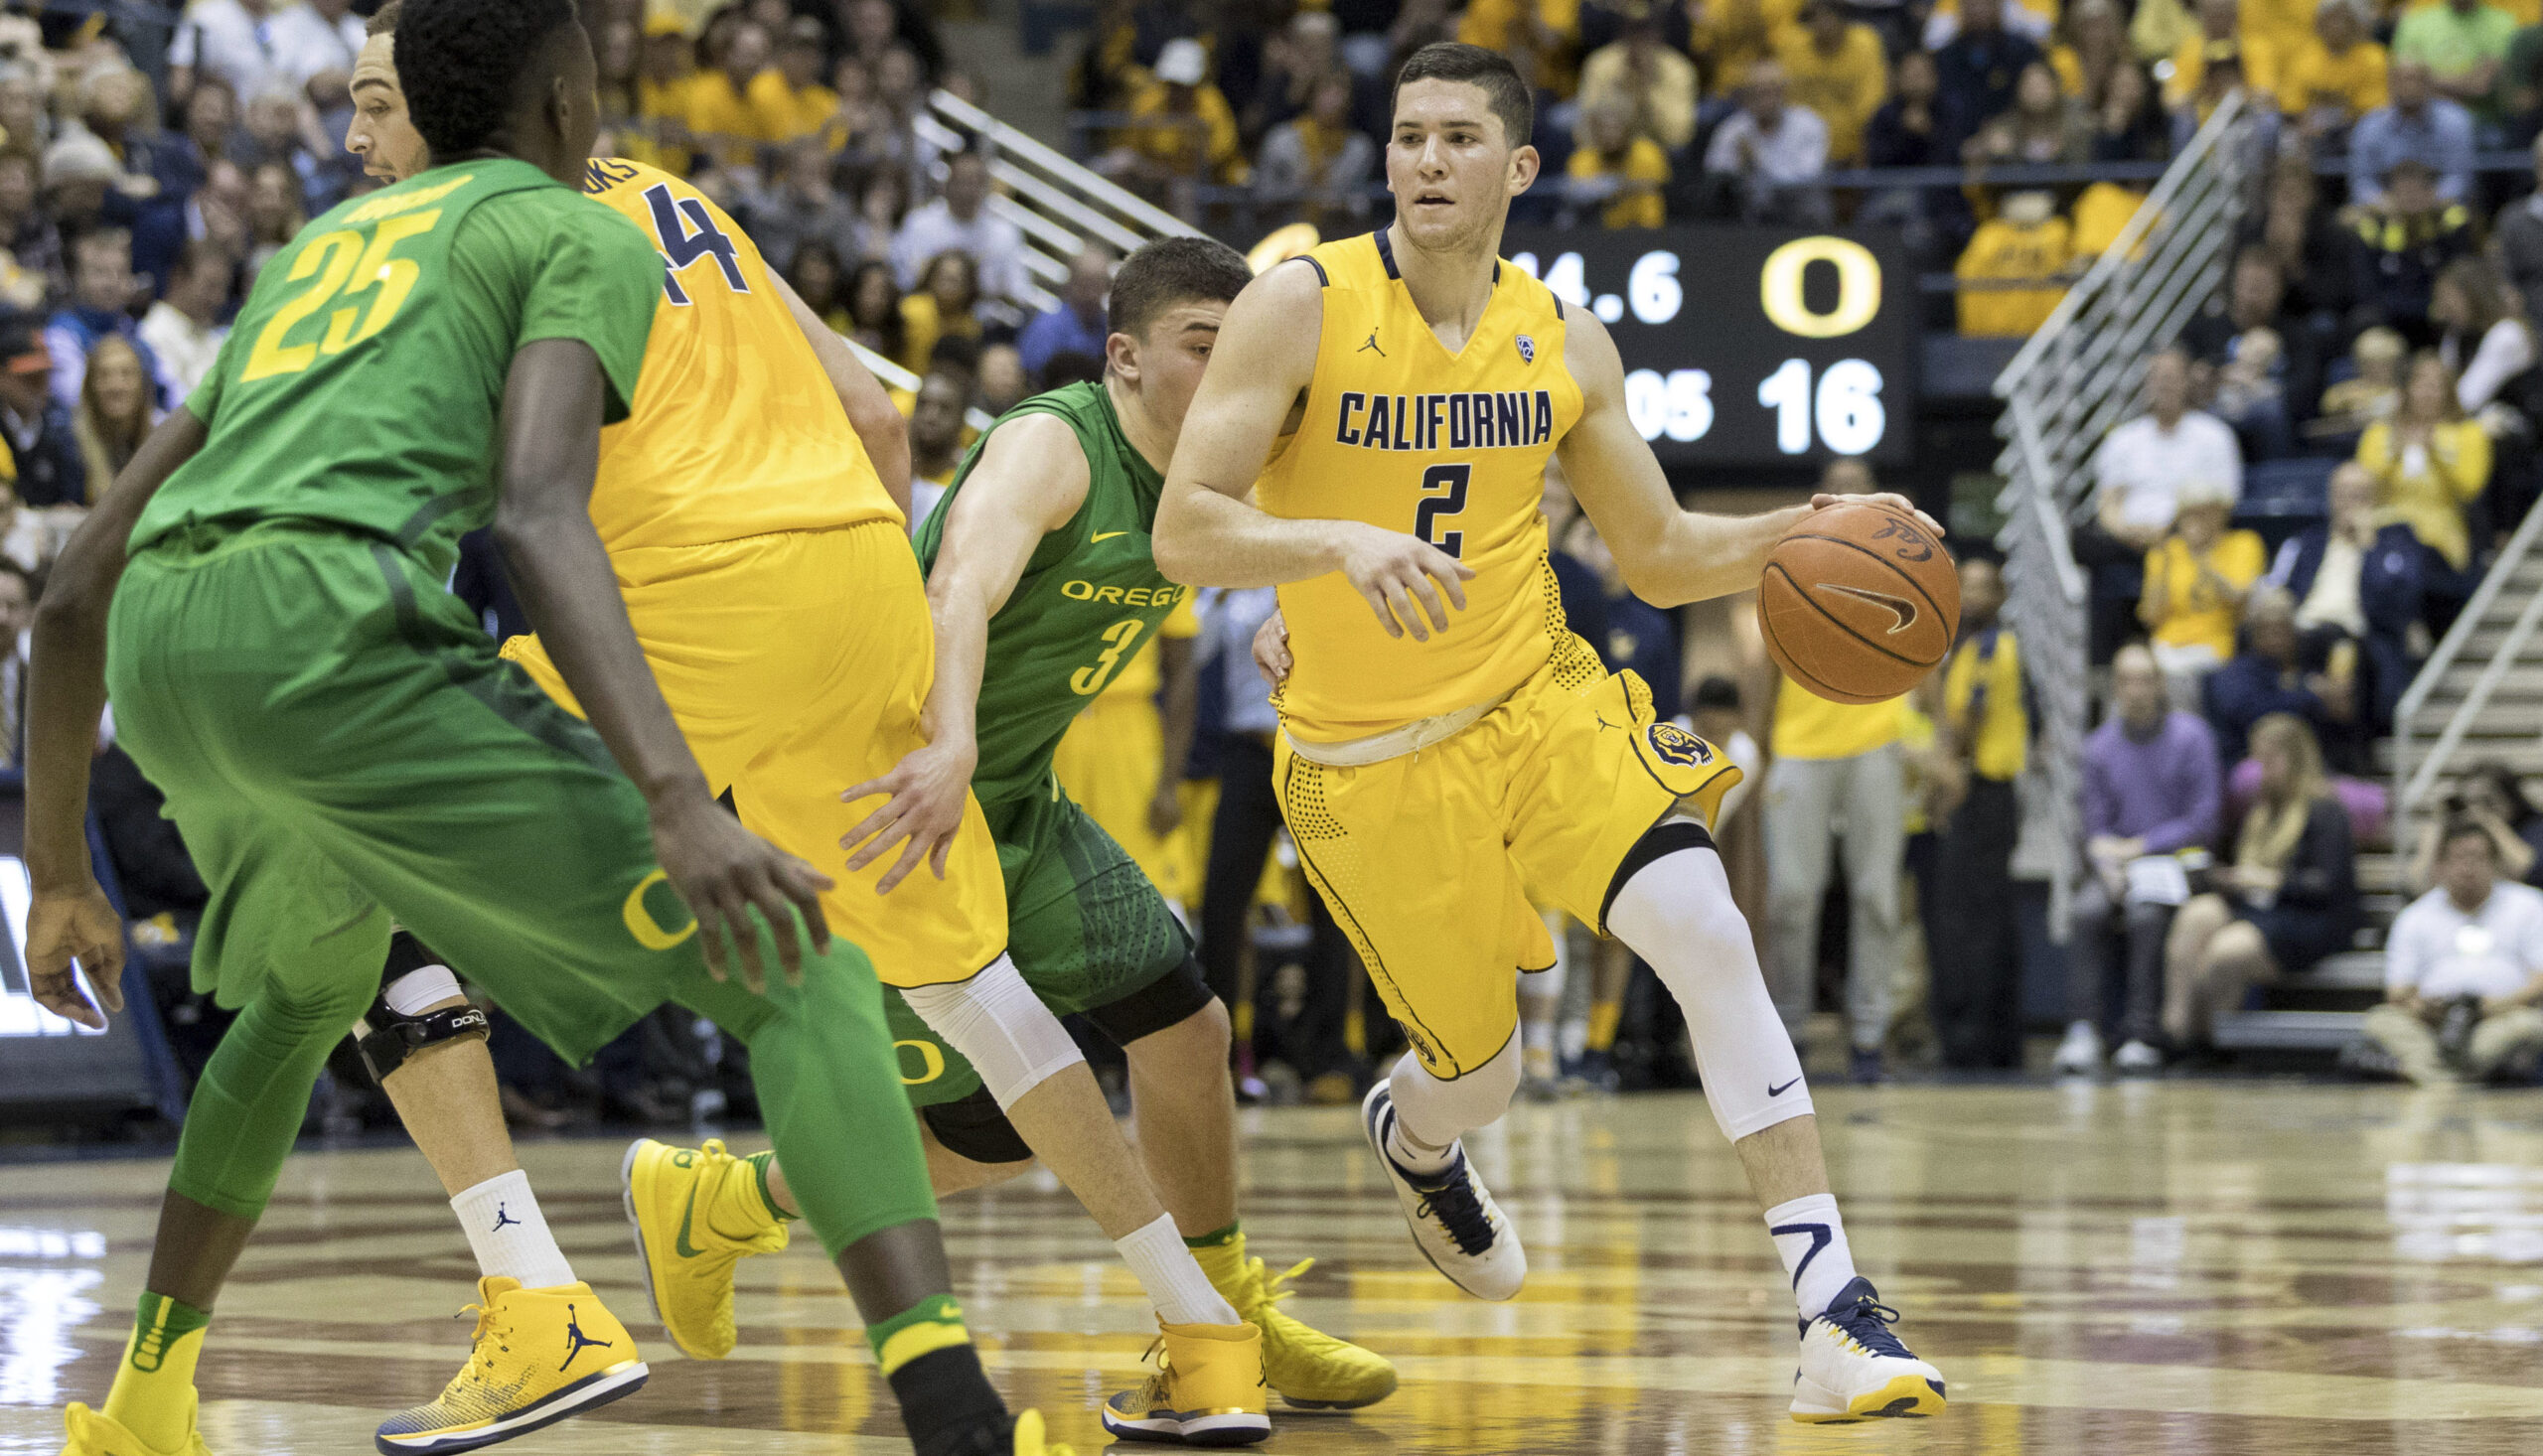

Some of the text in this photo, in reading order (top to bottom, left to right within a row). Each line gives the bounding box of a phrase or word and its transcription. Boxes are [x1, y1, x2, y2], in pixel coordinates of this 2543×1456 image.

[239, 209, 443, 383] 25
[1336, 390, 1553, 451] CALIFORNIA
[1758, 358, 1885, 455] 16
[1415, 463, 1472, 559] 2
[1070, 619, 1144, 695] 3
